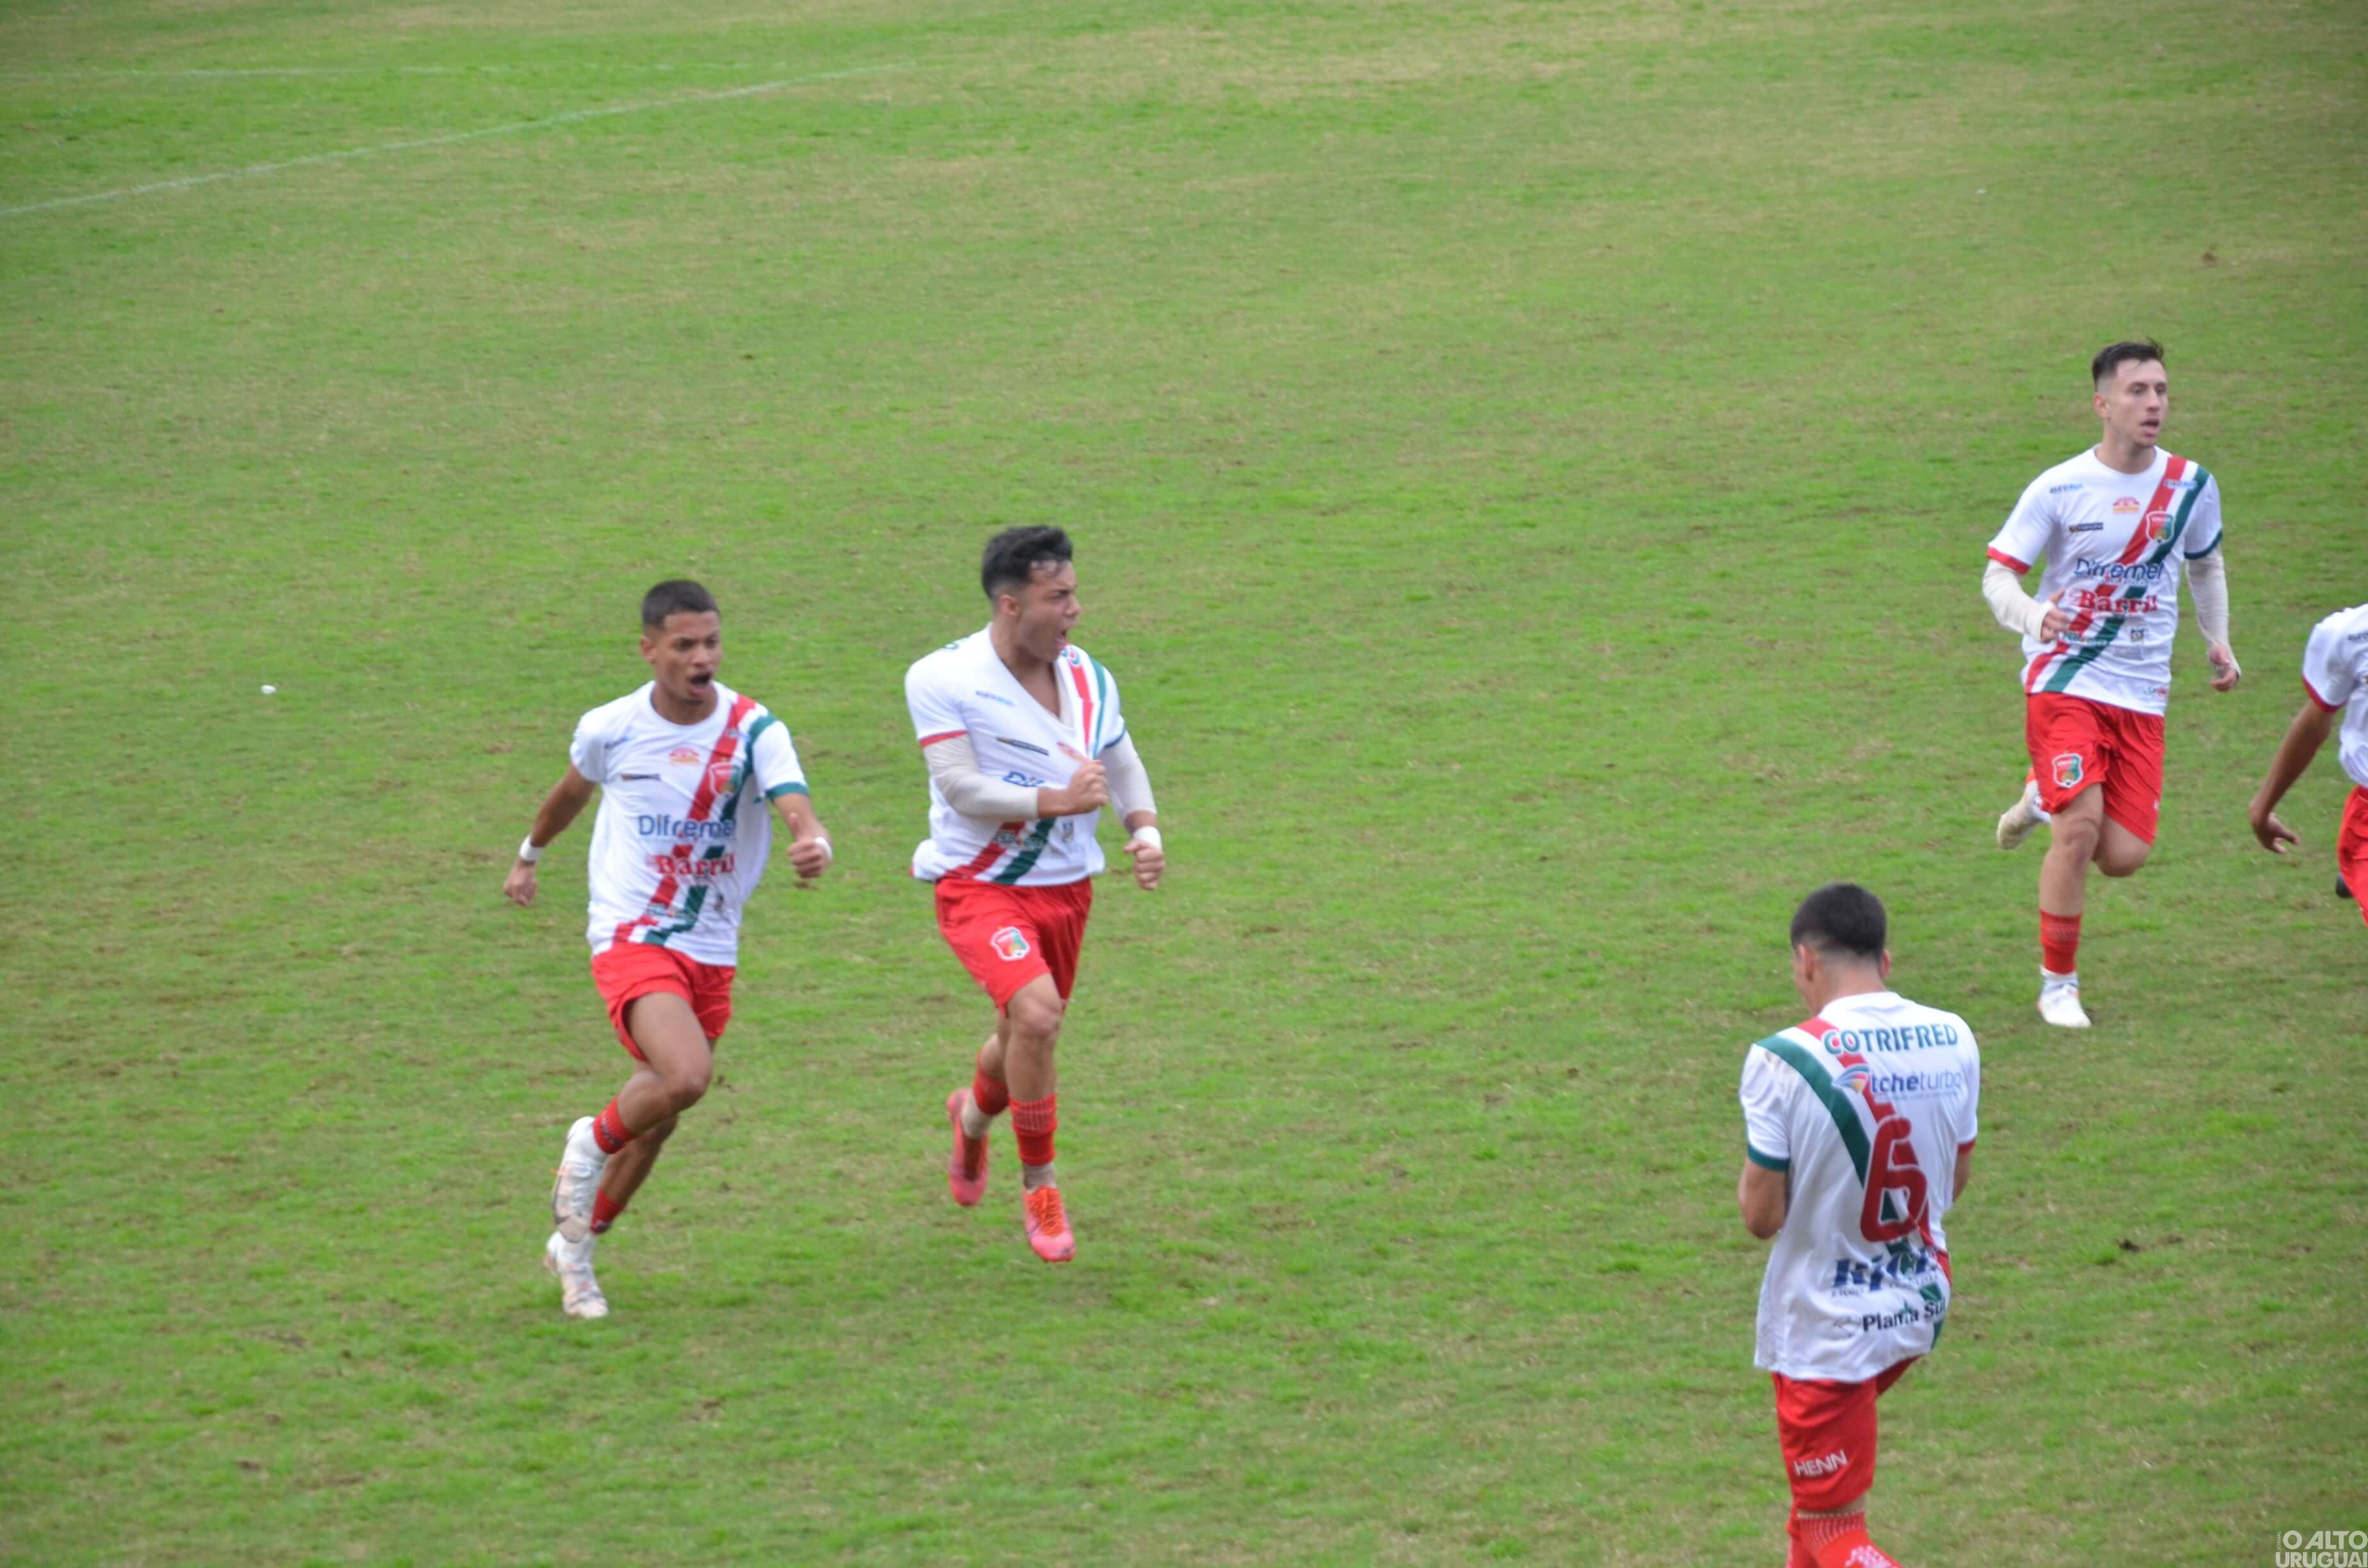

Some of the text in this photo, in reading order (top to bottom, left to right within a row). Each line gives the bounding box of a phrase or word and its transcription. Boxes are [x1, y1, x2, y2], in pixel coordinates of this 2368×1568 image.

[1823, 1023, 1959, 1056] COTRIFRED
[1860, 1116, 1928, 1243] 6
[1794, 1449, 1848, 1477] HENN
